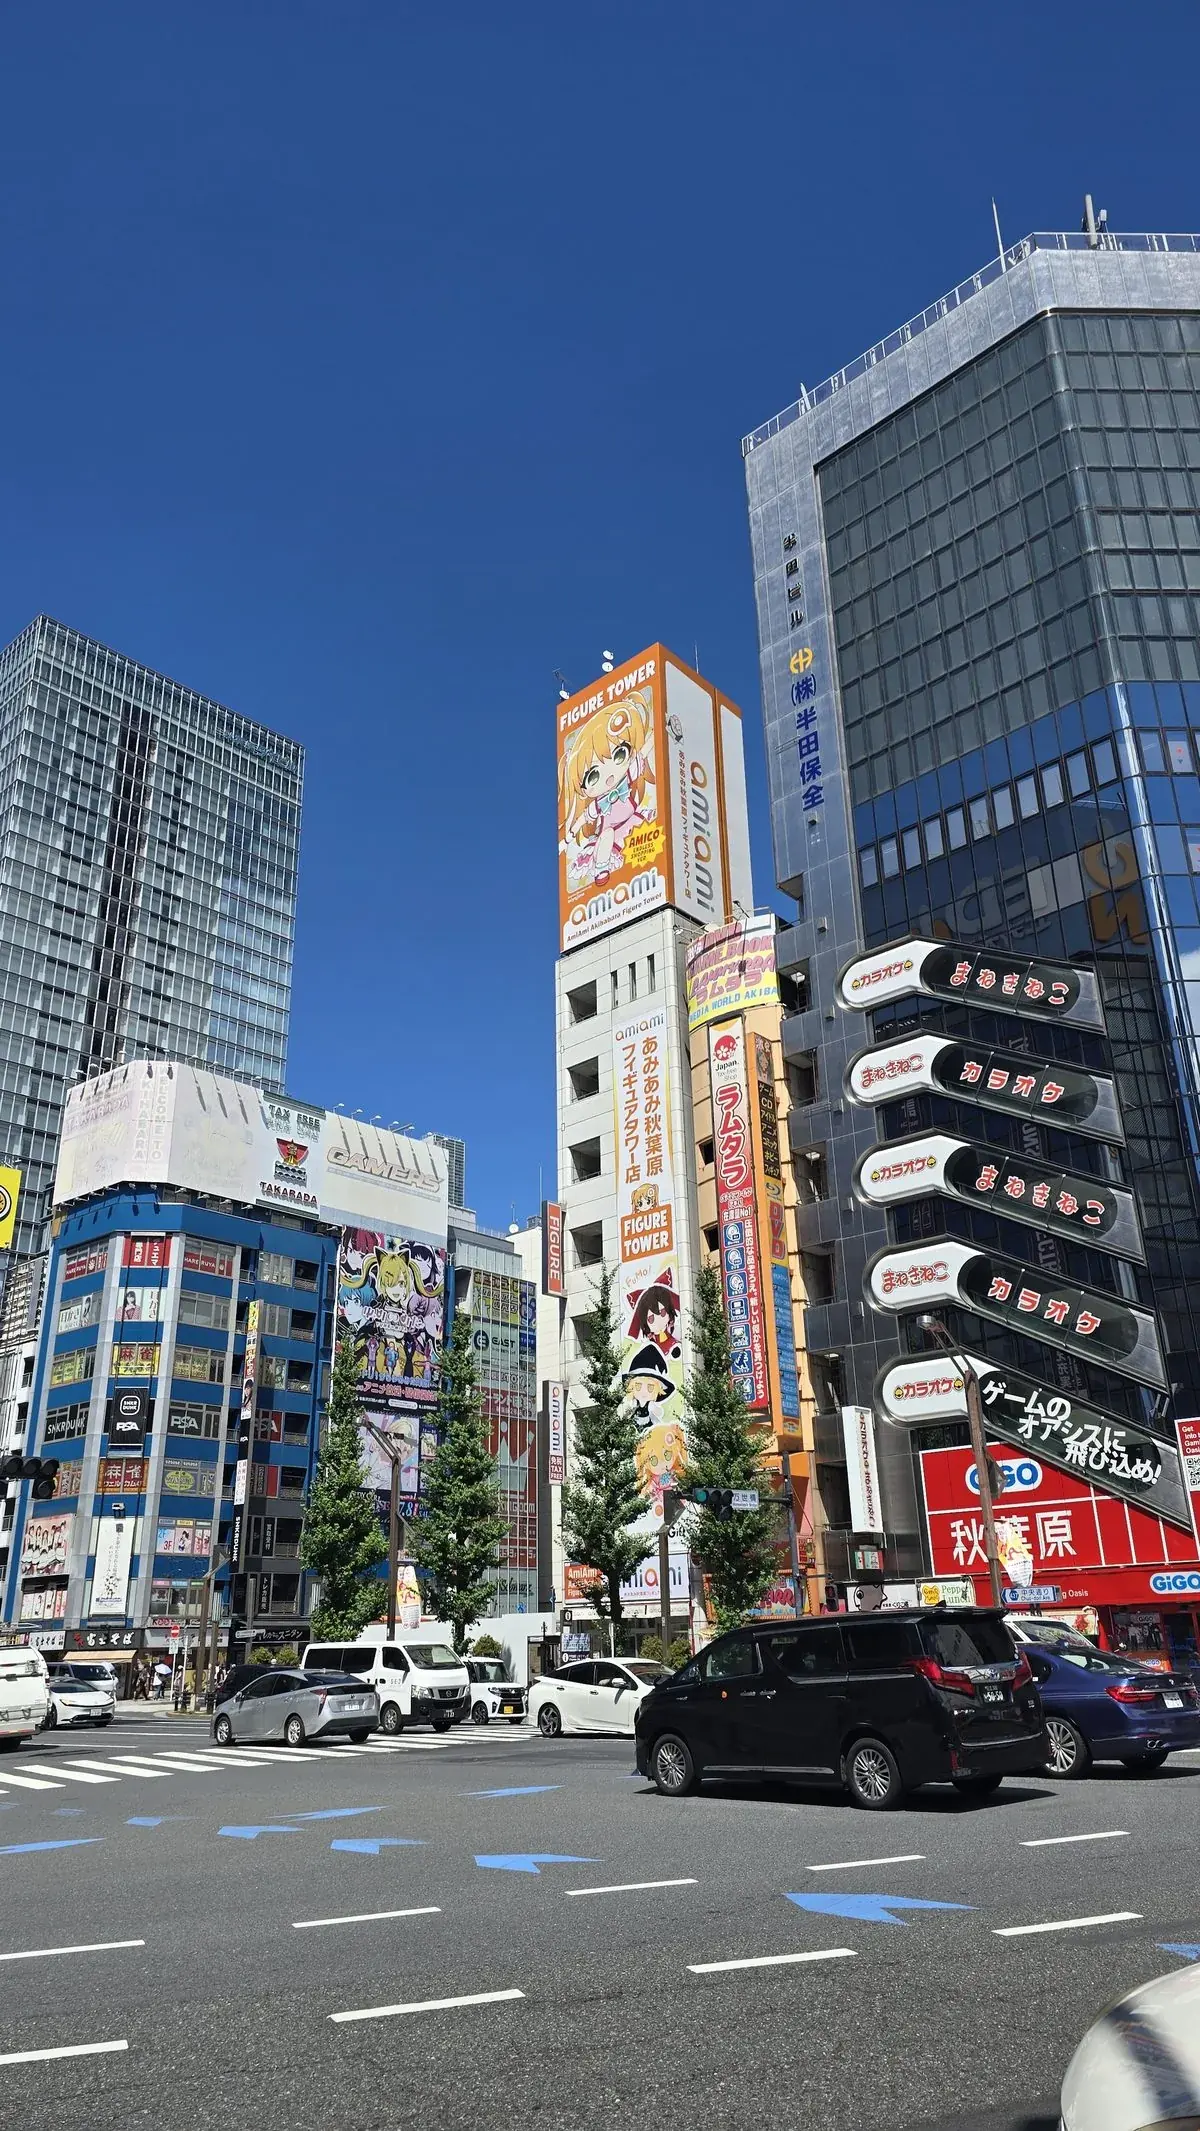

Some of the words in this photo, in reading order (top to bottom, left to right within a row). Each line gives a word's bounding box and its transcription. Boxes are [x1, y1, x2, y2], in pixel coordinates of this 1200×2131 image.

[559, 690, 604, 731] FIGURE
[606, 660, 656, 698] TOWER
[629, 829, 660, 847] AMICO
[691, 761, 715, 913] amiami
[572, 870, 656, 925] amiami
[567, 929, 590, 942] AmiAmi
[591, 912, 620, 931] Akihabara
[622, 902, 642, 916] Figure
[644, 893, 663, 906] Tower
[860, 961, 904, 986] カラオケ
[950, 961, 1069, 1005] まねきねこ
[712, 993, 740, 1009] WORLD
[745, 986, 777, 999] AKIBA
[616, 1013, 664, 1041] amiami
[861, 1053, 925, 1088] まねきねこ
[961, 1061, 1064, 1103] カラオケ
[268, 1104, 290, 1118] TAX
[297, 1113, 320, 1127] FREE
[622, 1043, 641, 1185] フィギュアタワー店
[641, 1036, 664, 1177] あみあみ秋葉原
[761, 1097, 773, 1109] CD
[716, 1083, 747, 1188] ラムタラ
[327, 1147, 444, 1193] GAMERS
[880, 1156, 927, 1179] カラオケ
[260, 1181, 318, 1203] TAKARADA
[976, 1166, 1105, 1225] まねきねこ
[624, 1209, 668, 1236] FIGURE
[769, 1201, 785, 1260] DVD
[550, 1216, 560, 1280] FIGURE
[624, 1231, 669, 1258] TOWER
[882, 1261, 950, 1294] まねきねこ
[988, 1277, 1101, 1335] カラオケ
[903, 1377, 954, 1398] カラオケ
[982, 1381, 1072, 1421] ゲームの
[116, 1421, 140, 1431] PSA
[170, 1415, 199, 1430] PSA
[552, 1387, 561, 1451] amiami
[1018, 1413, 1126, 1453] オアシスに
[1182, 1425, 1194, 1433] Get
[969, 1460, 1039, 1491] GGO
[164, 1541, 173, 1550] 3F
[232, 1516, 241, 1562] SNKRDUNK
[1021, 1588, 1049, 1596] 中央通り
[1068, 1588, 1089, 1598] Oasis
[1152, 1574, 1200, 1592] GiGO
